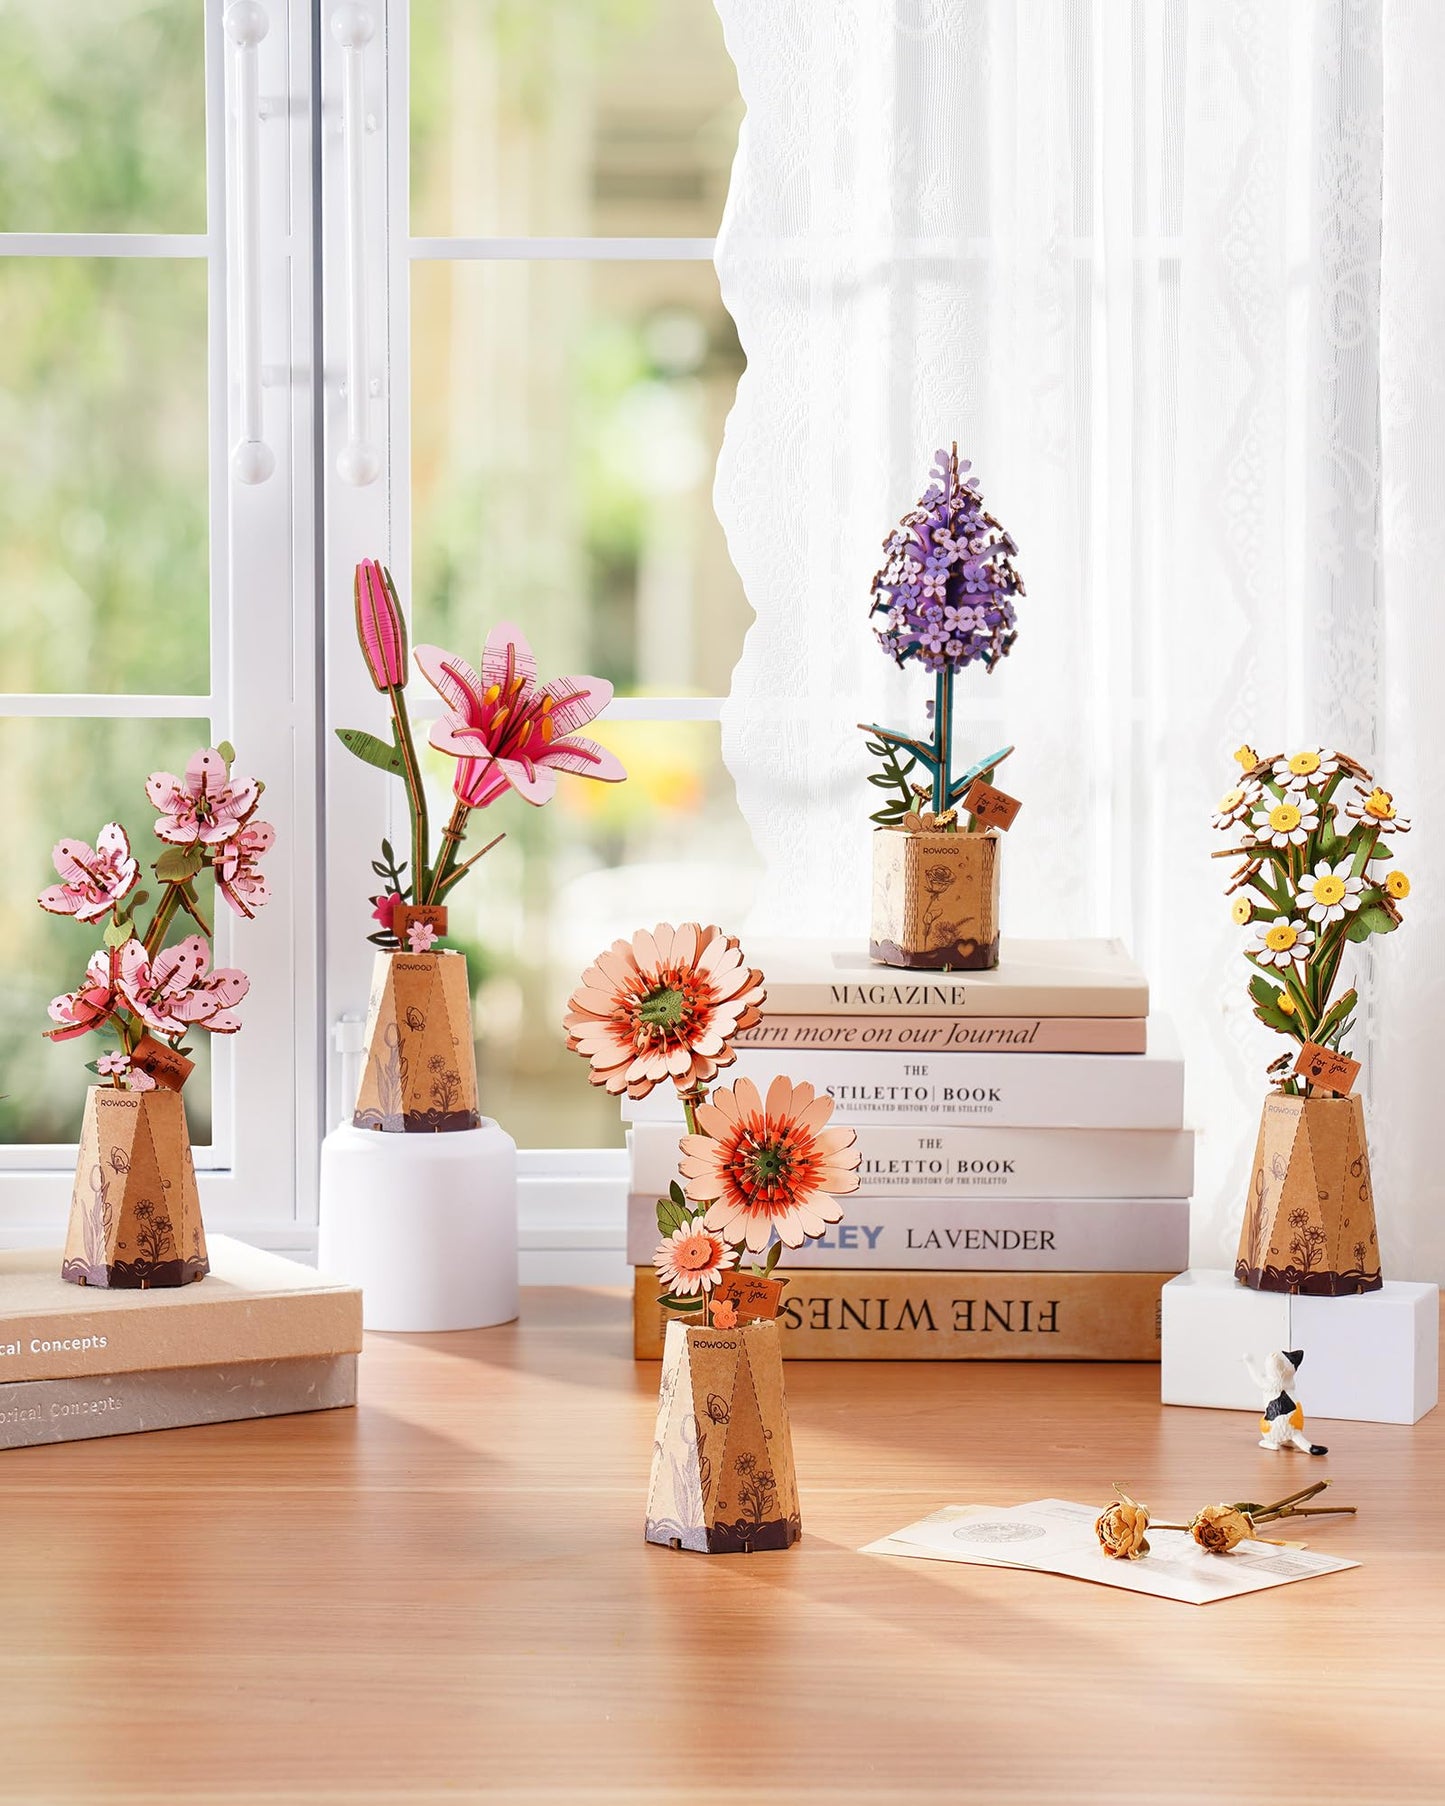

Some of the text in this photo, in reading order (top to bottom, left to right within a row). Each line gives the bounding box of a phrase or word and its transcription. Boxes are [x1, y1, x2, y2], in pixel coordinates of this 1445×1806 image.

[991, 803, 1008, 814] you
[922, 847, 960, 855] ROWOOD
[396, 963, 432, 972] ROWOOD
[830, 985, 966, 1005] MAGAZINE
[734, 1022, 1041, 1047] earn more on our Journal
[904, 1065, 929, 1076] THE
[1328, 1062, 1347, 1074] you
[826, 1085, 1001, 1102] STILETTO BOOK
[100, 1099, 138, 1108] ROWOOD
[846, 1103, 896, 1112] ILLUSTRATED
[897, 1104, 928, 1112] HISTORY
[930, 1104, 940, 1112] OF
[942, 1105, 956, 1113] THE
[958, 1105, 993, 1113] STILETTO
[1268, 1104, 1300, 1116] ROWOOD
[918, 1138, 943, 1149] THE
[855, 1160, 1015, 1173] ILETTO BOOK
[911, 1177, 942, 1185] HISTORY
[944, 1177, 954, 1185] OF
[957, 1177, 970, 1185] THE
[972, 1177, 1008, 1185] STILETTO
[906, 1228, 1057, 1250] LAVENDER
[749, 1289, 768, 1303] you
[784, 1297, 1061, 1333] FINE WINES
[30, 1335, 108, 1353] Concepts
[693, 1340, 737, 1349] ROWOOD
[50, 1397, 123, 1418] Concepts
